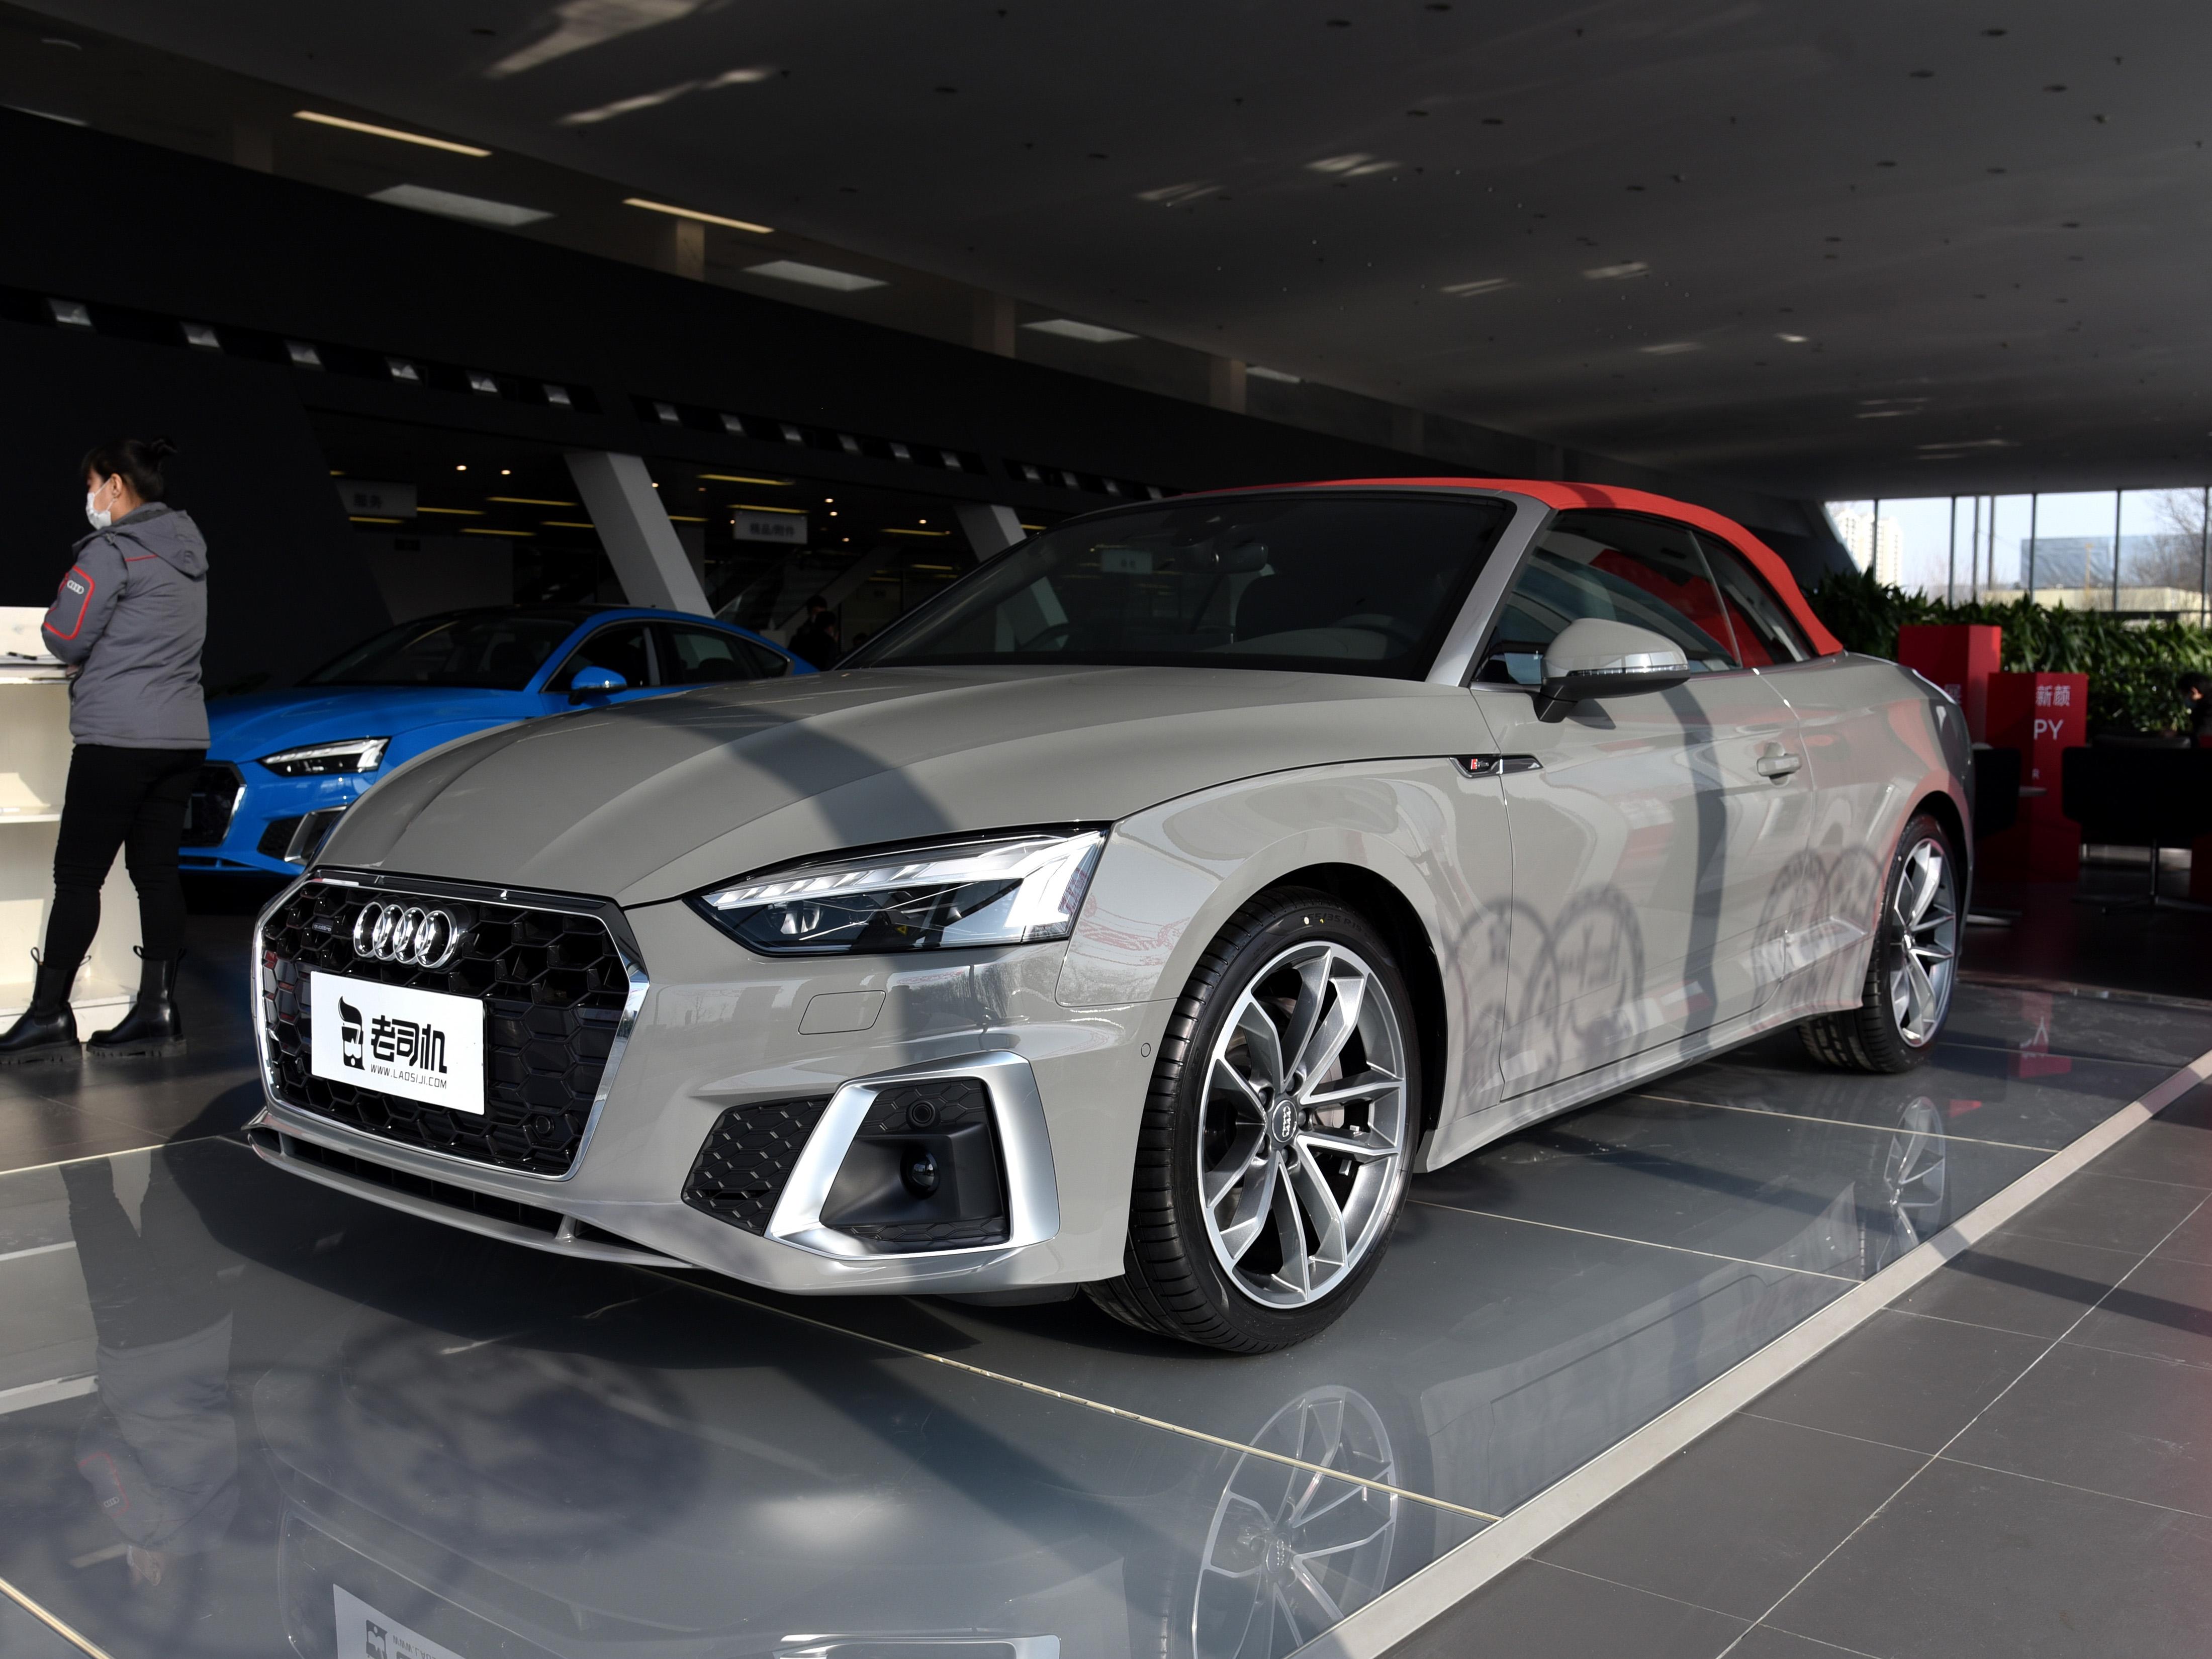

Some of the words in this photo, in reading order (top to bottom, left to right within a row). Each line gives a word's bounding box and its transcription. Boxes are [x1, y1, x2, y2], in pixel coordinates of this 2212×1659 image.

[2036, 685, 2070, 707] 新颜
[2034, 718, 2064, 740] PY
[371, 1015, 447, 1073] 老司机
[371, 1064, 446, 1089] WWW.LAOSIJI.COM
